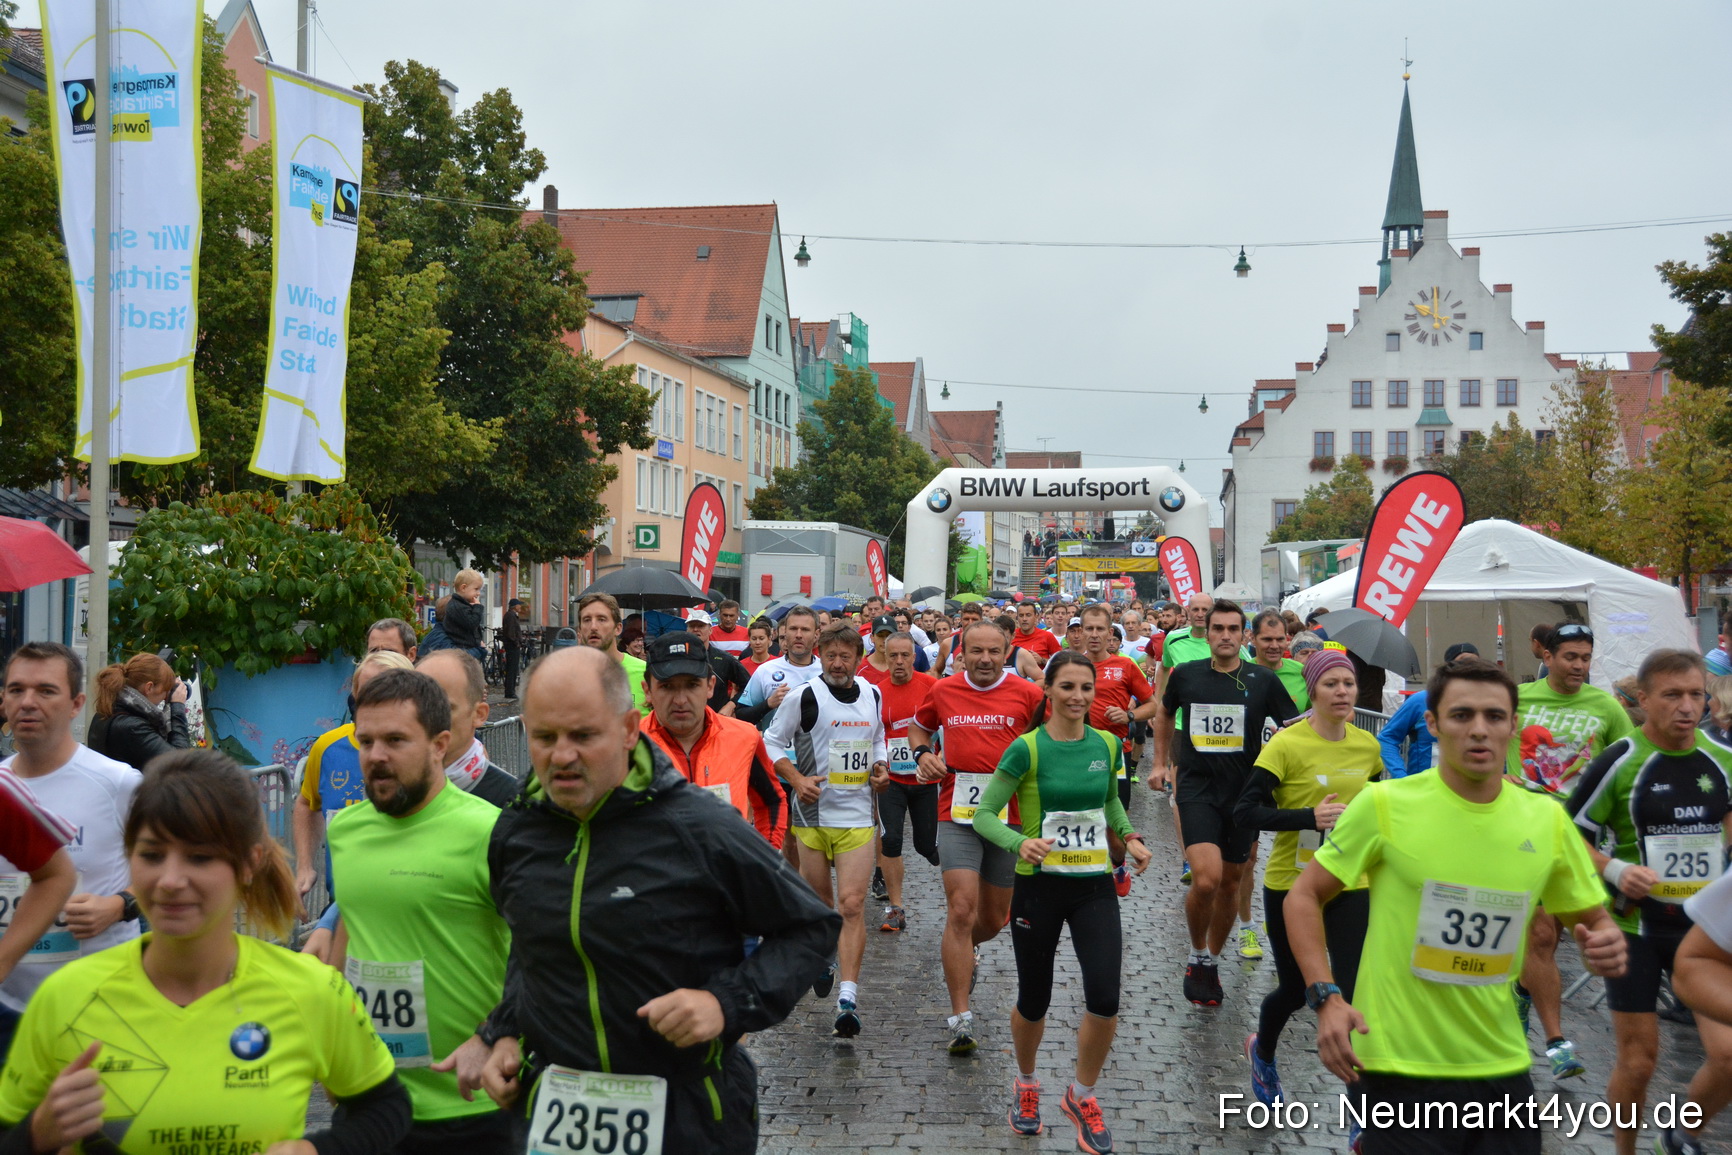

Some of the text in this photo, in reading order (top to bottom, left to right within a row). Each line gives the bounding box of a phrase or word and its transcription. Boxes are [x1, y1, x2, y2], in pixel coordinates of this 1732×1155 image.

[960, 477, 1151, 501] BMW Laufsport
[638, 528, 656, 546] D
[687, 500, 719, 592] EWE
[1097, 560, 1120, 569] ZIEL
[1363, 492, 1451, 621] REWE
[947, 714, 1005, 727] NEUMARKT
[1201, 716, 1234, 734] 182
[1521, 704, 1601, 737] HELFER
[1205, 737, 1229, 746] Daniel
[841, 751, 868, 771] 184
[891, 747, 912, 761] 26
[1673, 806, 1704, 819] DAV
[1056, 825, 1096, 848] 314
[1061, 853, 1092, 864] Bettina
[1664, 852, 1710, 878] 235
[1441, 908, 1512, 950] 337
[1451, 955, 1487, 973] Felix
[149, 1123, 241, 1145] THE NEXT
[541, 1097, 651, 1155] 2358
[204, 1139, 263, 1155] YEARS
